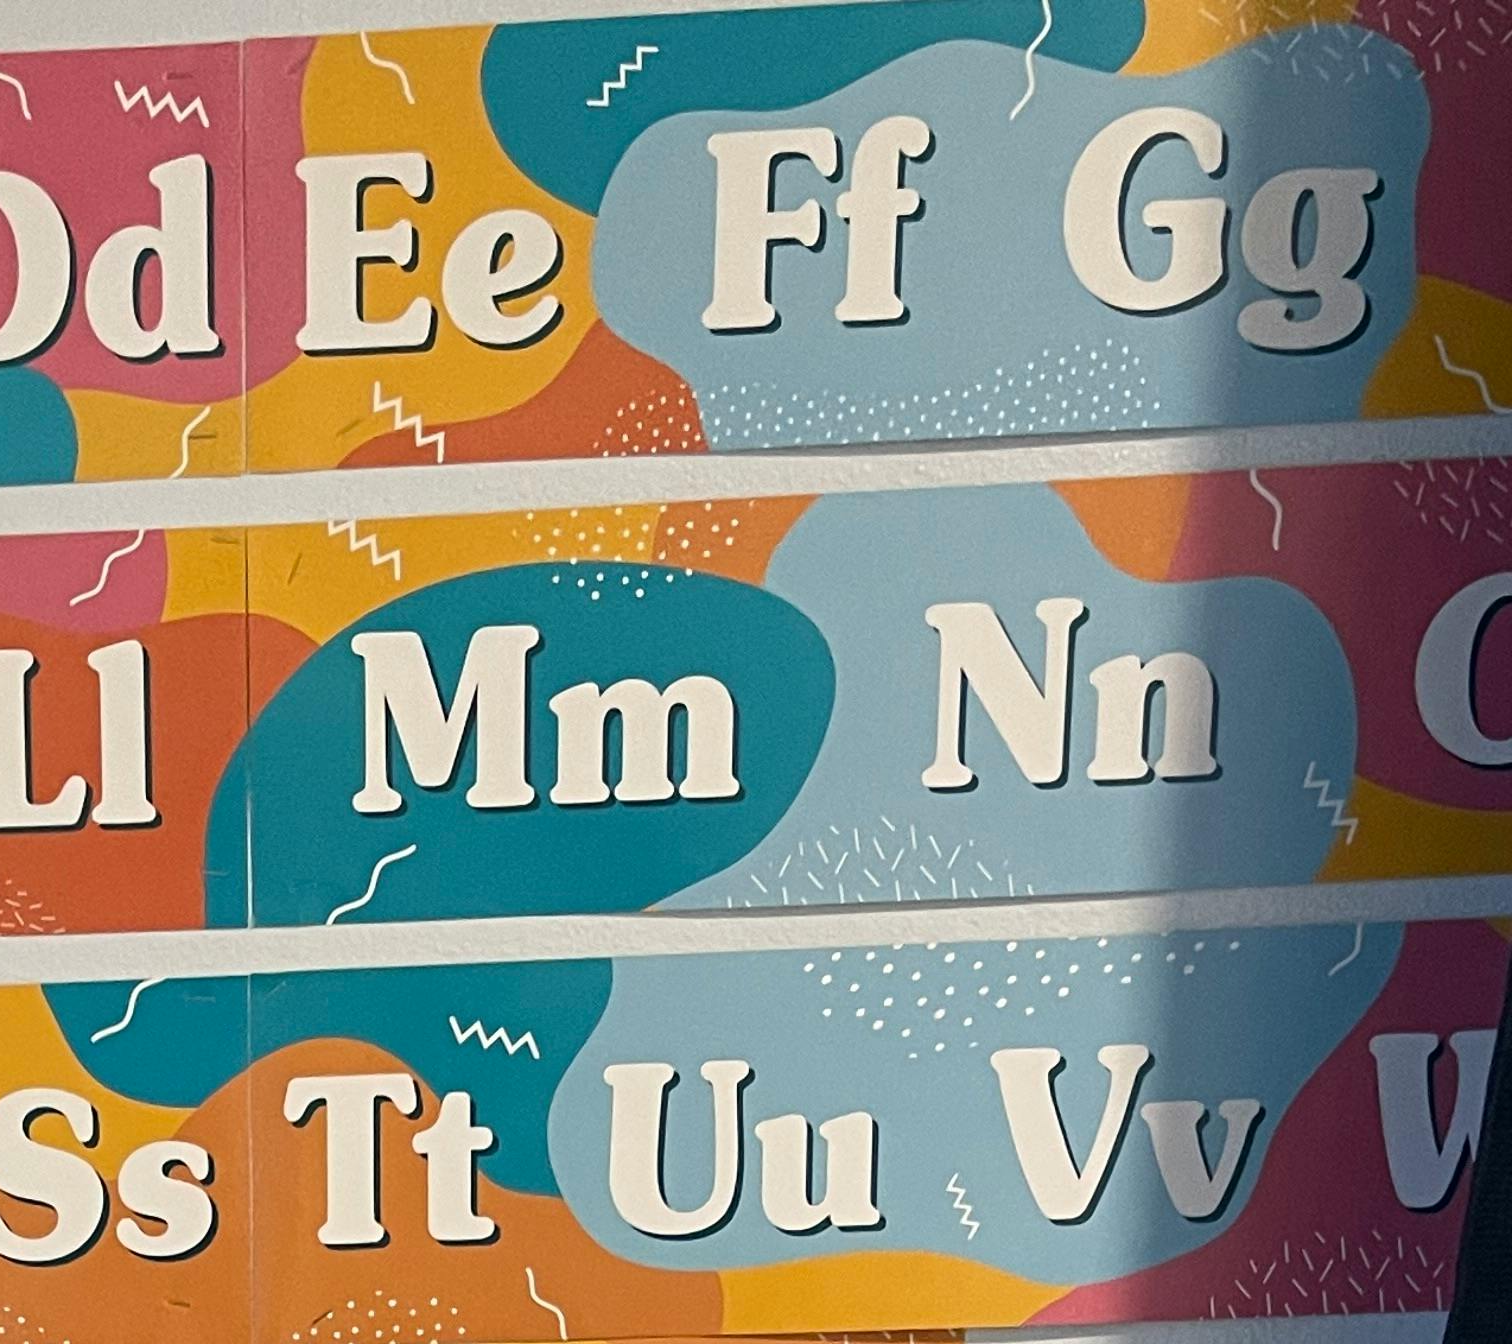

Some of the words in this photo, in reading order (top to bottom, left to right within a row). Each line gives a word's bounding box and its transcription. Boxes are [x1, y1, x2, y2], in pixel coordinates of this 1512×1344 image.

[296, 152, 563, 356] Ee
[702, 116, 934, 334] Ff
[1064, 107, 1384, 354] Gg
[351, 625, 743, 812] Mm
[921, 598, 1222, 793] Nn
[284, 1074, 500, 1248] Tt
[604, 1060, 885, 1238] Uu
[991, 1044, 1264, 1224] Vv
